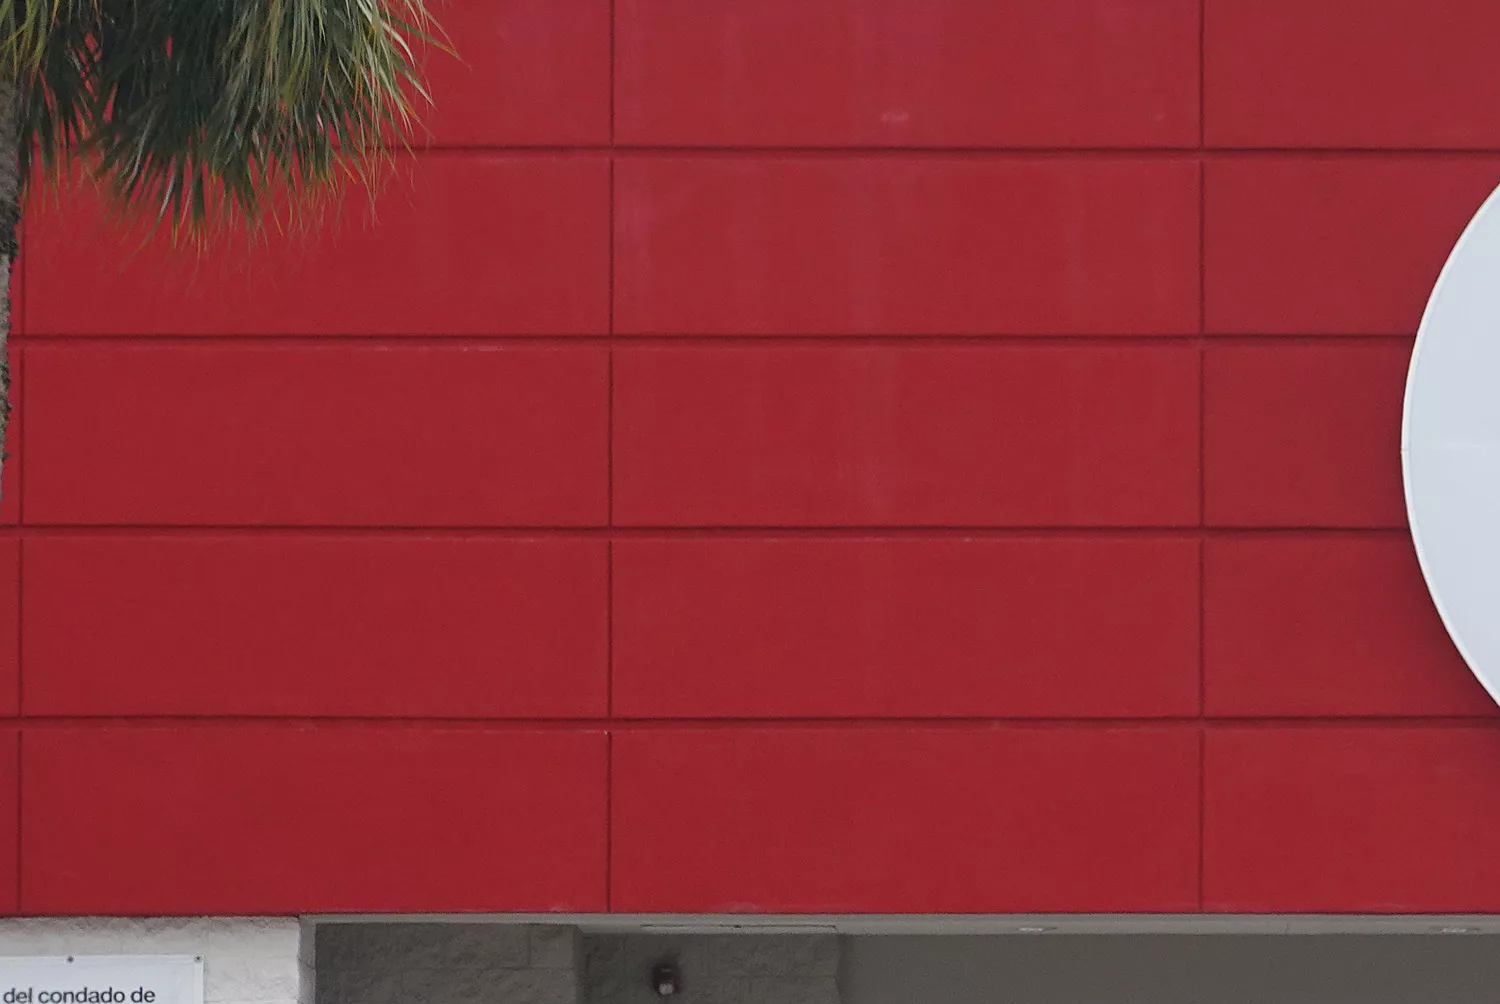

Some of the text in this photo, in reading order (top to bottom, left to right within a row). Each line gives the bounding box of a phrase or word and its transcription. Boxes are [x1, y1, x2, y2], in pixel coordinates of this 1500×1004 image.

[3, 986, 156, 1004] del condado de
